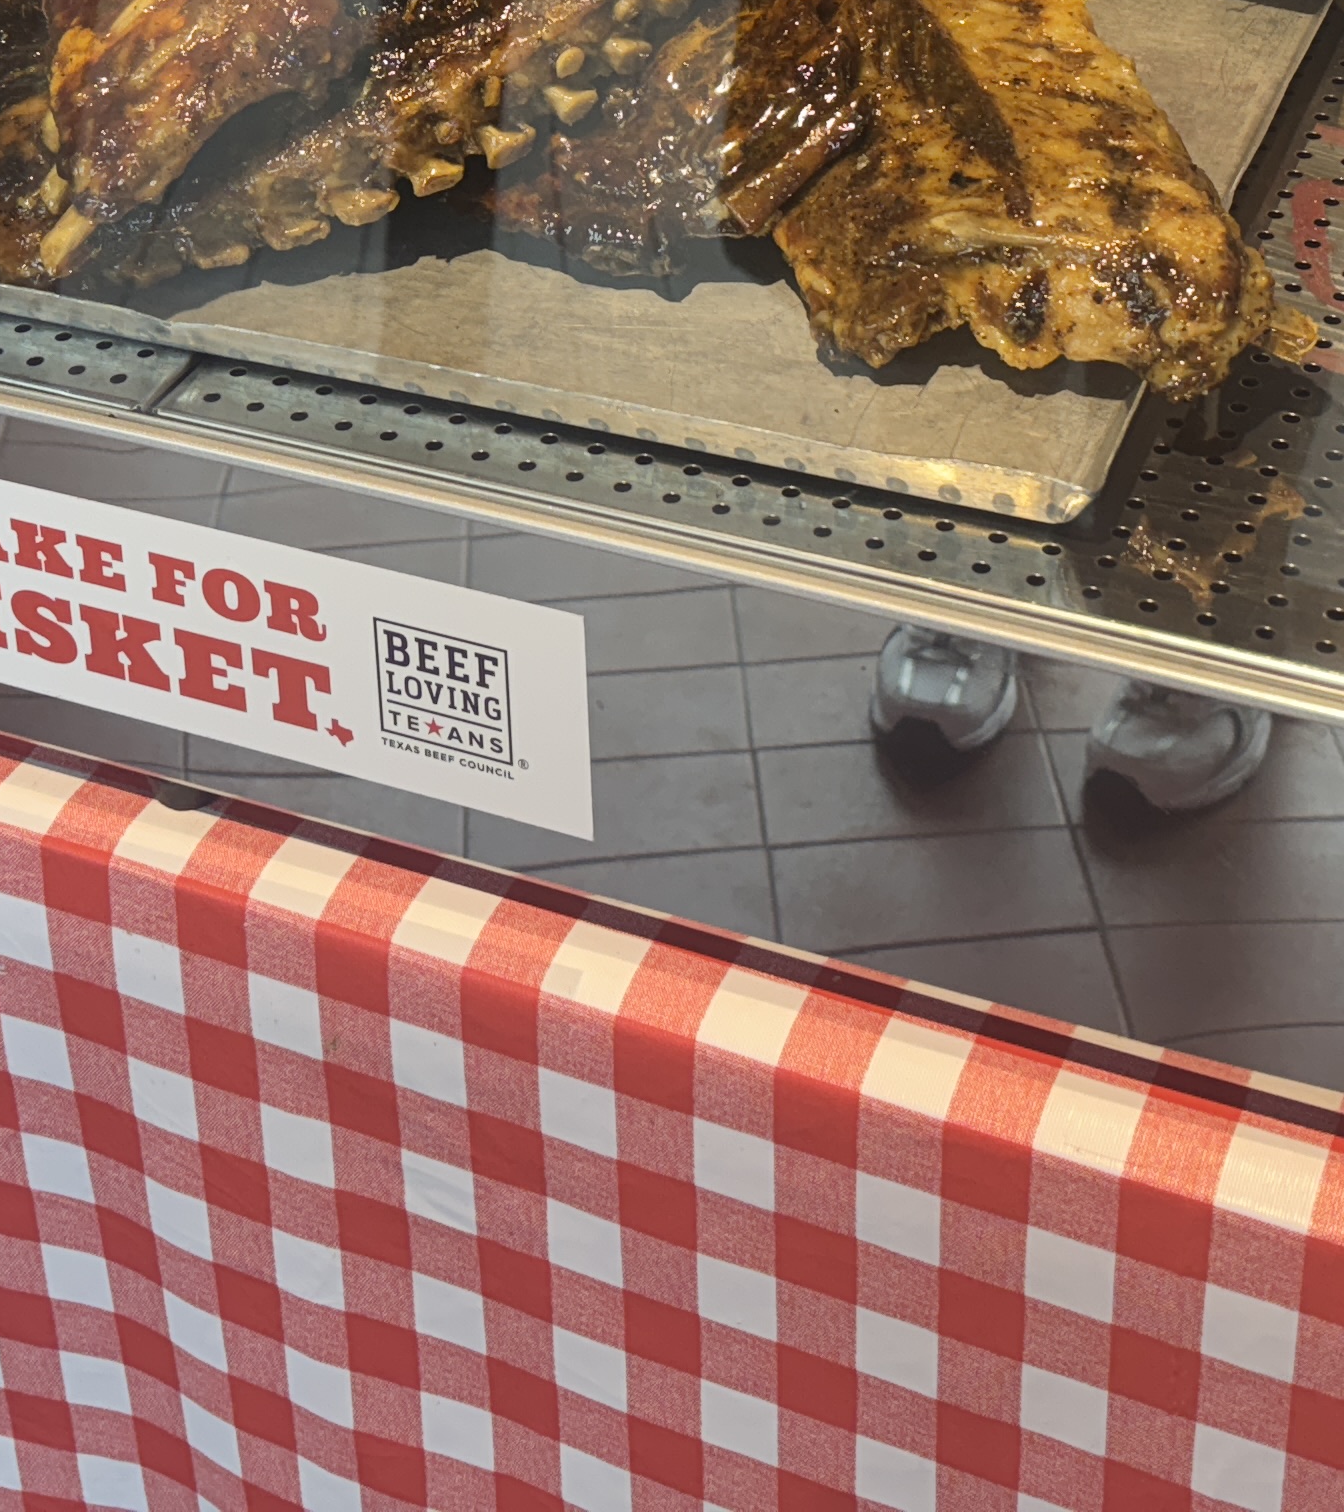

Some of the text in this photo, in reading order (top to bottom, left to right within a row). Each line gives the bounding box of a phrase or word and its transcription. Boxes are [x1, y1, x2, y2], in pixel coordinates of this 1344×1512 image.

[148, 551, 327, 642] FOR
[383, 629, 498, 689] BEEF
[386, 670, 502, 721] LOVING
[381, 736, 515, 780] TEXAS BEEF COUNCIL
